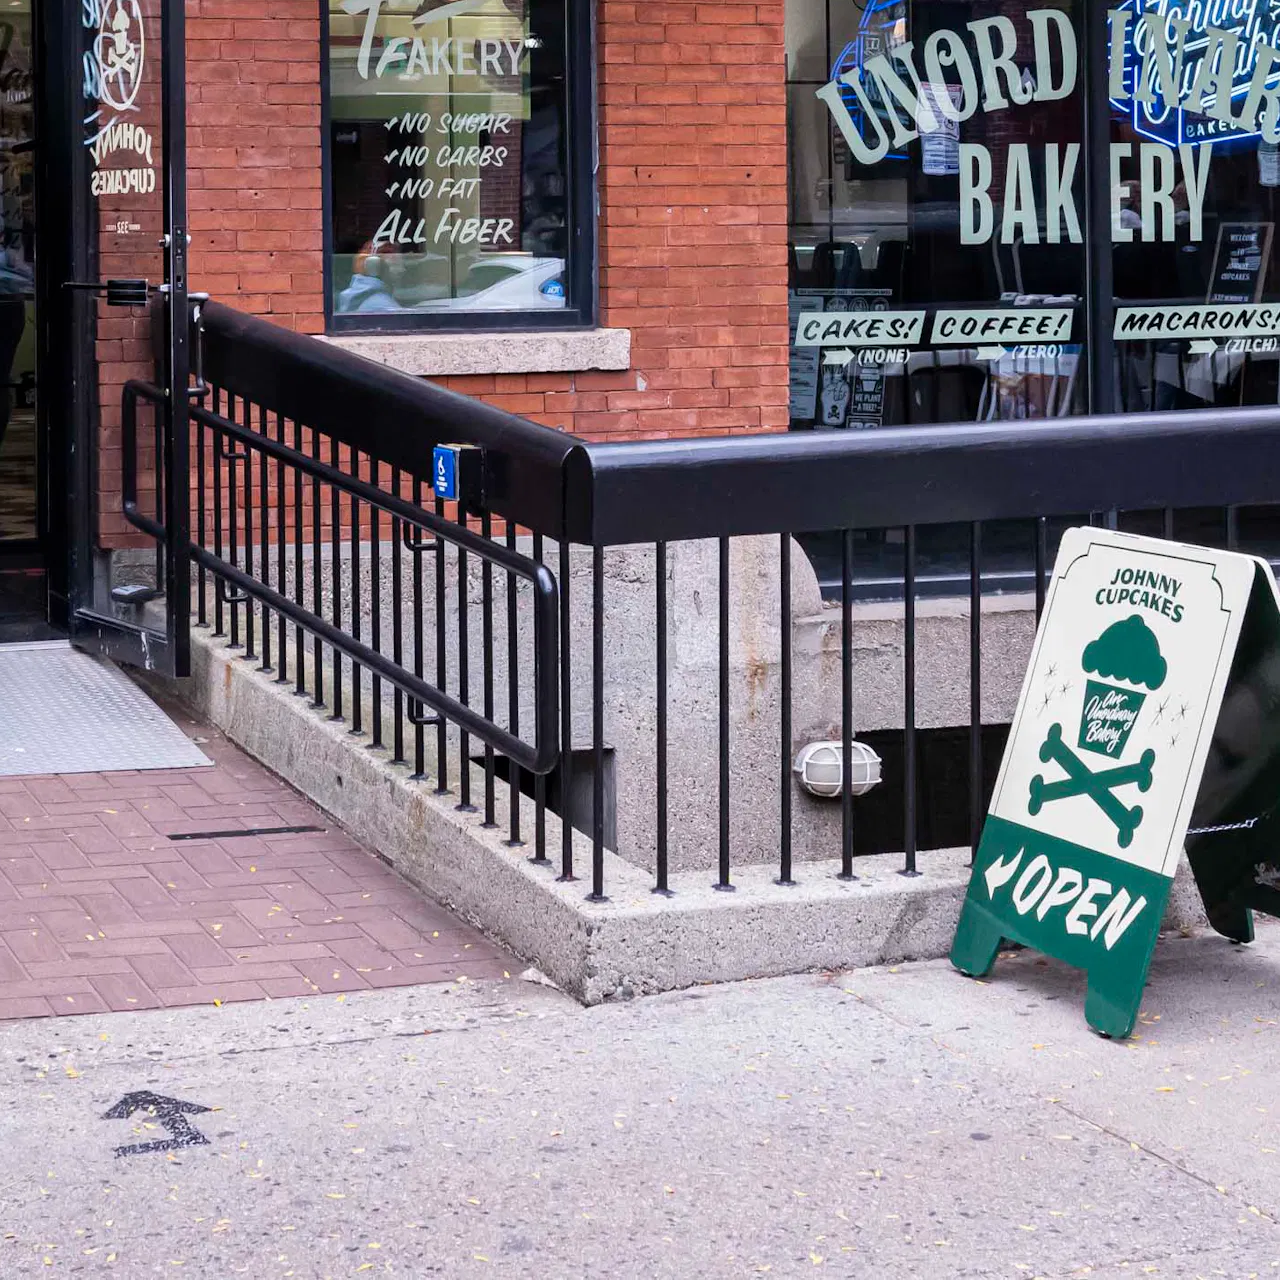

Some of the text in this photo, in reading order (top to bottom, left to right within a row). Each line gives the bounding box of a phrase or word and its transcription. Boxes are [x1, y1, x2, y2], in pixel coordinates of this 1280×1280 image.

[399, 112, 512, 134] NO SUGAR
[399, 145, 508, 168] NO CARBS
[400, 177, 482, 200] NO FAT
[803, 314, 1068, 341] CAKES! COFFEE!
[857, 344, 1063, 367] (NONE) (ZERO)
[1224, 337, 1278, 355] (ZILCH)
[1110, 568, 1183, 598] JOHNNY
[1095, 588, 1185, 623] CUPCAKES
[1085, 695, 1138, 731] Unordinary
[1086, 719, 1123, 753] Bakery
[1012, 853, 1148, 952] OPEN
